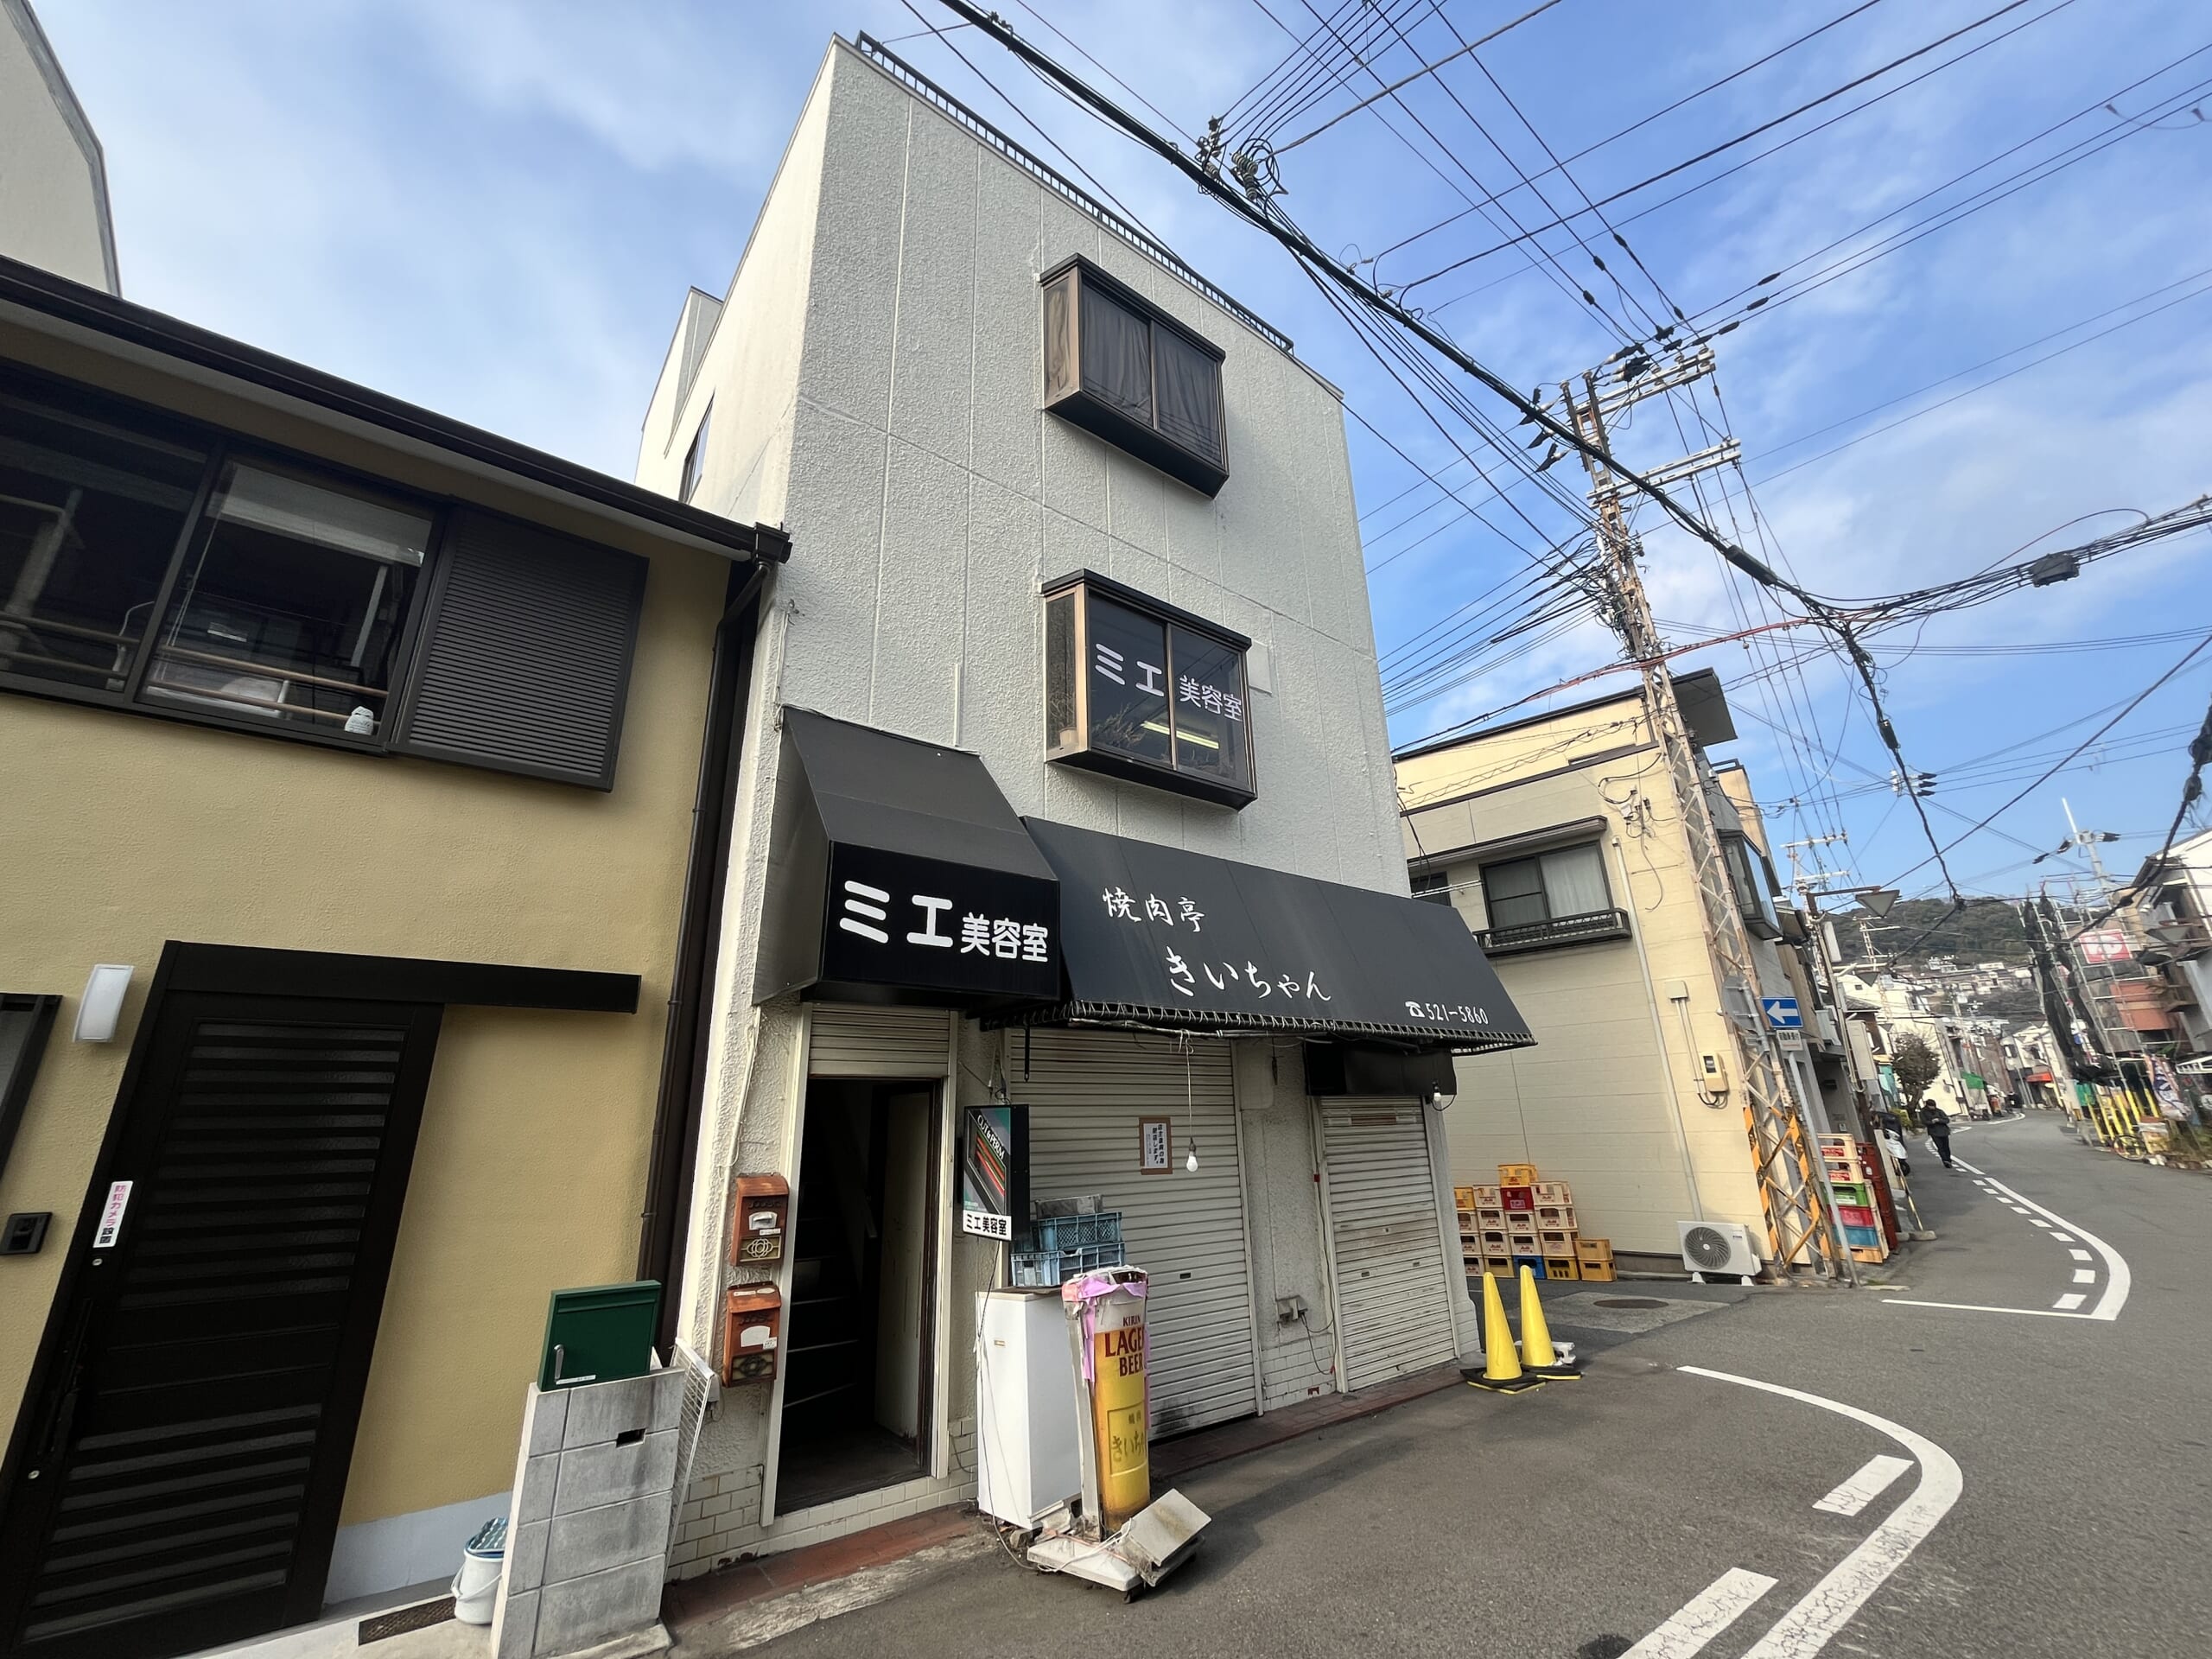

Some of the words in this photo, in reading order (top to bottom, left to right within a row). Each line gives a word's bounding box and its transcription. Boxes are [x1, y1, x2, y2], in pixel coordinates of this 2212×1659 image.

[1102, 886, 1205, 933] 焼肉亭
[1163, 945, 1332, 1003] きいちゃん
[1425, 1002, 1489, 1025] 521-5860
[966, 1213, 1007, 1236] ミエ美容室
[1122, 1315, 1141, 1326] KIRIN
